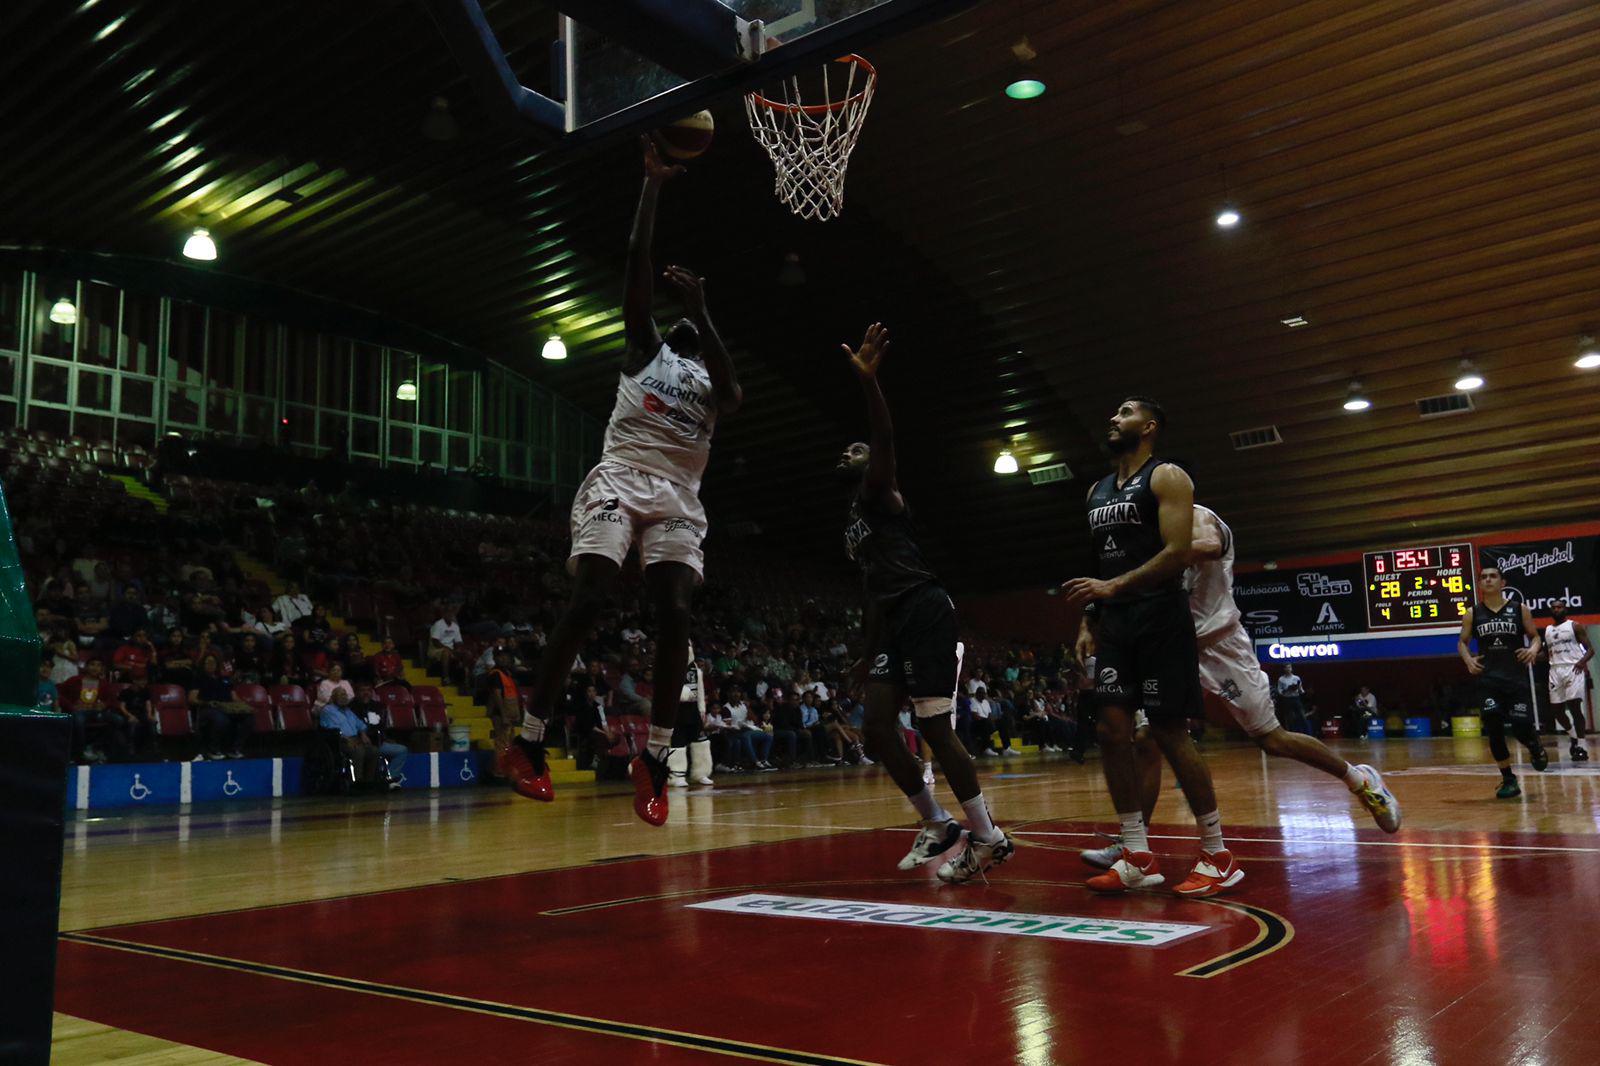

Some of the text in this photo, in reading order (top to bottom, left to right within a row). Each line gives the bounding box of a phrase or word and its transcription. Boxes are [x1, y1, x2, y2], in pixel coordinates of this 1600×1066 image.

[1396, 549, 1429, 568] 25.4
[1451, 553, 1460, 566] 2
[1376, 560, 1385, 573] 0
[1437, 568, 1463, 576] HOME
[1374, 573, 1401, 582] GUEST
[1415, 577, 1423, 589] 2
[1381, 581, 1400, 598] 28
[1442, 576, 1463, 593] 48
[1381, 608, 1391, 620] 4
[1428, 604, 1438, 617] 3
[1456, 602, 1467, 616] 5
[1477, 621, 1518, 637] TIJUANA
[1269, 643, 1340, 659] Chevron
[736, 899, 1174, 941] SaludDigna
